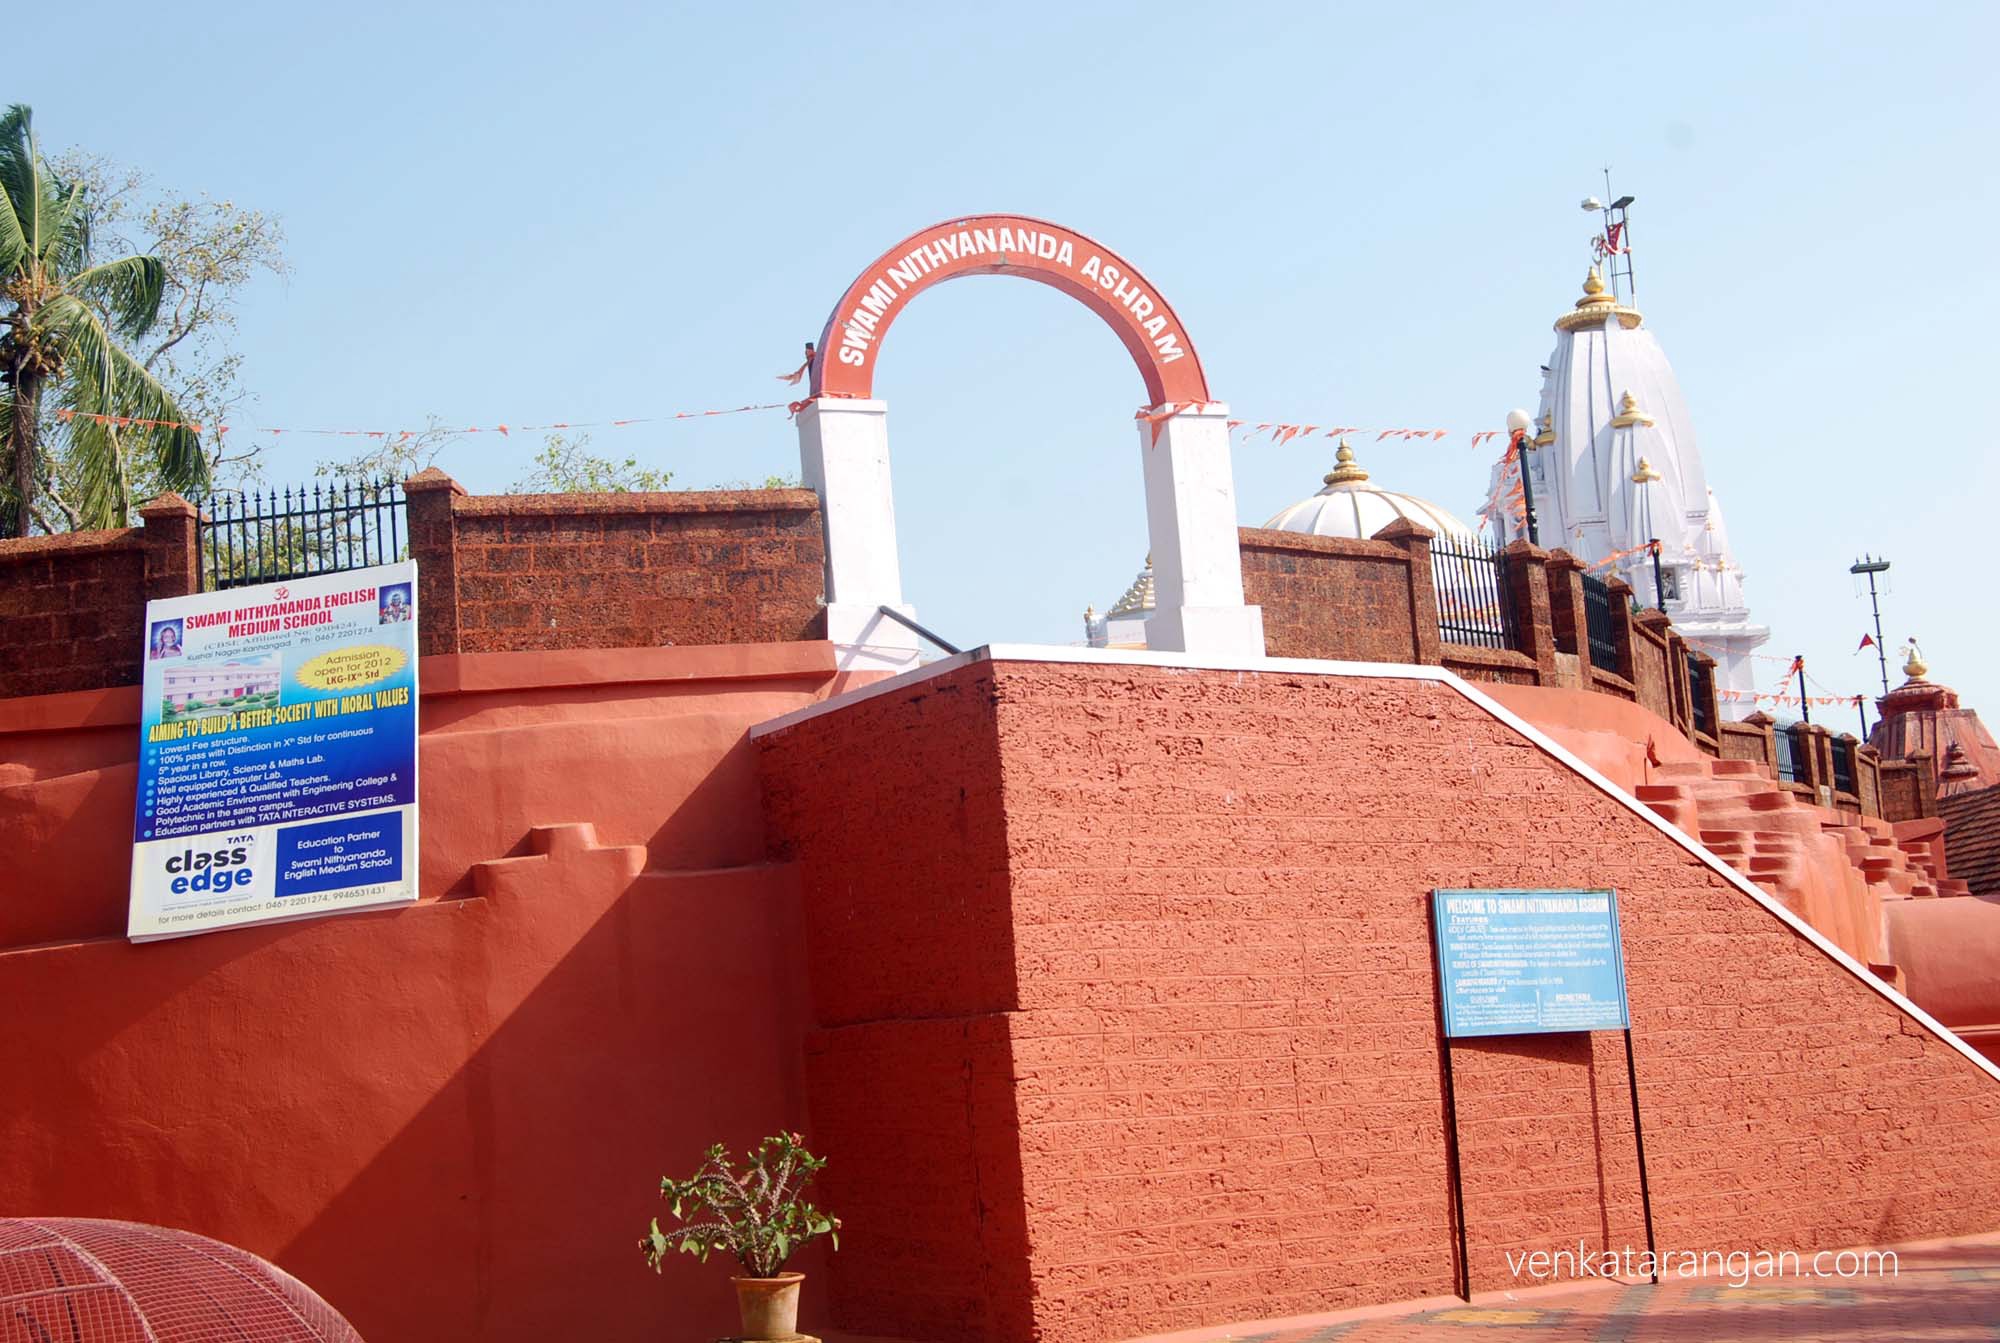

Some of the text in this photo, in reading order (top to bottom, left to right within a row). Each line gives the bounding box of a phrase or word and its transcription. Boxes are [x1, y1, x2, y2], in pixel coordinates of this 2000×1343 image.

[839, 227, 1185, 367] SWAMI NITHYANANDA ASHRAM
[186, 587, 376, 630] SWAMI NITHYANANDA ENGLISH
[228, 610, 333, 638] MEDIUM SCHOOL
[187, 648, 213, 661] Kushal
[315, 633, 335, 642] 0467
[338, 627, 373, 638] 2201274
[245, 631, 290, 644] Affiliated
[314, 657, 391, 677] open for 2012
[326, 650, 380, 665] Admission
[365, 670, 380, 680] Std
[148, 687, 409, 743] AIMING TO BUILD A BETTER SOCIETY WITH MORAL VALUES
[160, 735, 249, 755] Lowest Fee structure.
[160, 754, 183, 765] 100%
[186, 752, 206, 763] pass
[208, 747, 225, 757] with
[228, 742, 272, 756] Distinction
[273, 741, 281, 749] in
[297, 735, 312, 745] Std
[314, 733, 325, 743] for
[327, 727, 374, 740] continuous
[158, 754, 325, 786] Spacious Library, Science & Maths Lab.
[171, 763, 190, 775] year
[191, 761, 200, 770] in
[210, 760, 227, 769] row.
[156, 773, 397, 816] Good Academic Environment with Engineering College &
[157, 770, 282, 795] Well equipped Computer Lab.
[157, 775, 331, 807] Highly experienced & Qualified Teachers.
[155, 801, 296, 826] Polytechnic in the same campus.
[155, 793, 396, 837] Education partners with TATA INTERACTIVE SYSTEMS.
[227, 834, 254, 845] TATA
[297, 830, 381, 849] Education Partner
[333, 845, 344, 853] to
[165, 847, 247, 874] class
[284, 857, 393, 880] English Medium School
[291, 848, 386, 870] Swami Nithyananda
[170, 864, 253, 894] edge
[158, 916, 171, 925] for
[172, 913, 194, 922] more
[196, 907, 225, 919] details
[265, 900, 287, 909] 0467
[333, 886, 385, 899] 9946531431
[1447, 898, 1486, 914] WELCOME
[1487, 898, 1496, 914] TO
